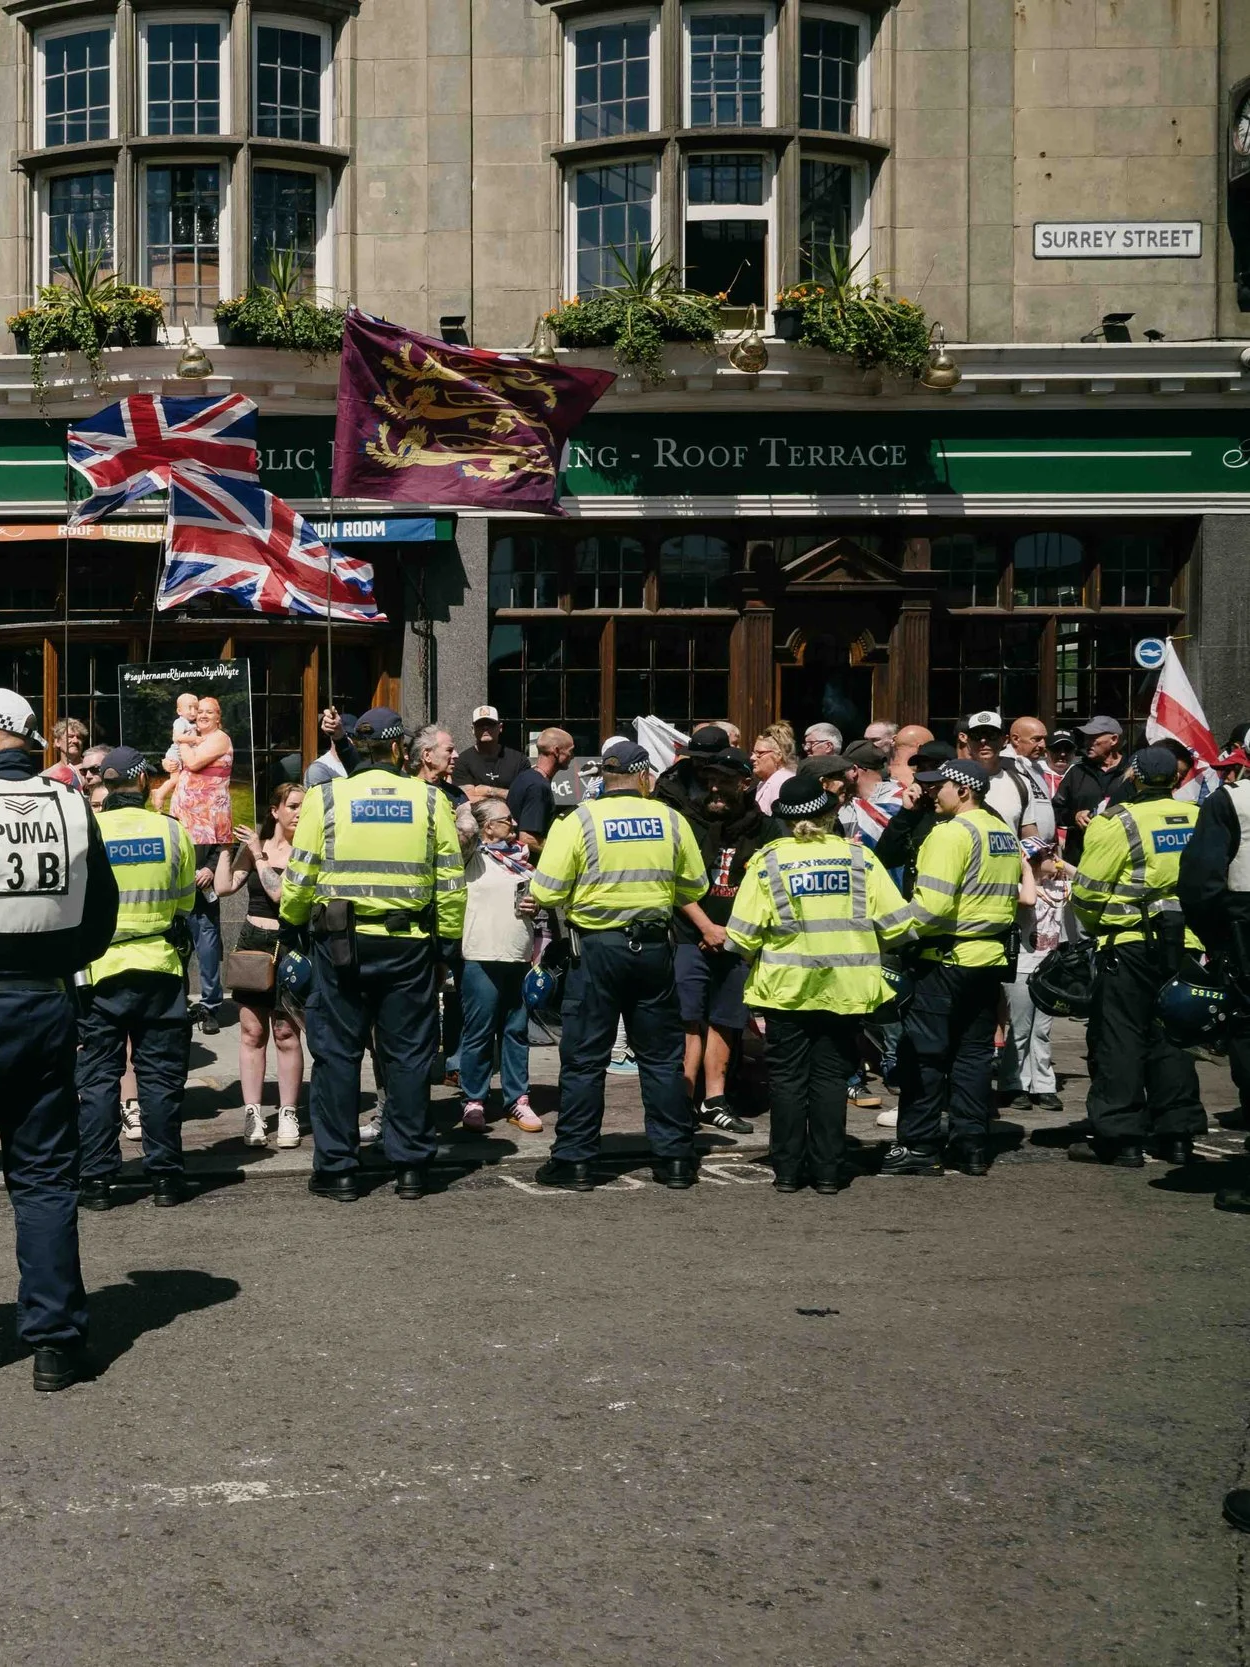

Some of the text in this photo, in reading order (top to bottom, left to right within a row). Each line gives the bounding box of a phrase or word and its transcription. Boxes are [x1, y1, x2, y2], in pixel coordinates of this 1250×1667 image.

[1041, 229, 1193, 249] SURREY STREET
[58, 525, 166, 539] ROOF TERRACE
[342, 520, 386, 538] ROOM
[124, 664, 239, 684] #sayhernameRhiannonSkyeWhyte
[354, 805, 410, 817] POLICE
[605, 819, 662, 838] POLICE
[990, 834, 1019, 851] POLICE
[1157, 832, 1194, 847] POLIC
[109, 842, 162, 858] POLICE
[6, 852, 60, 890] 3 B
[791, 873, 848, 894] POLICE
